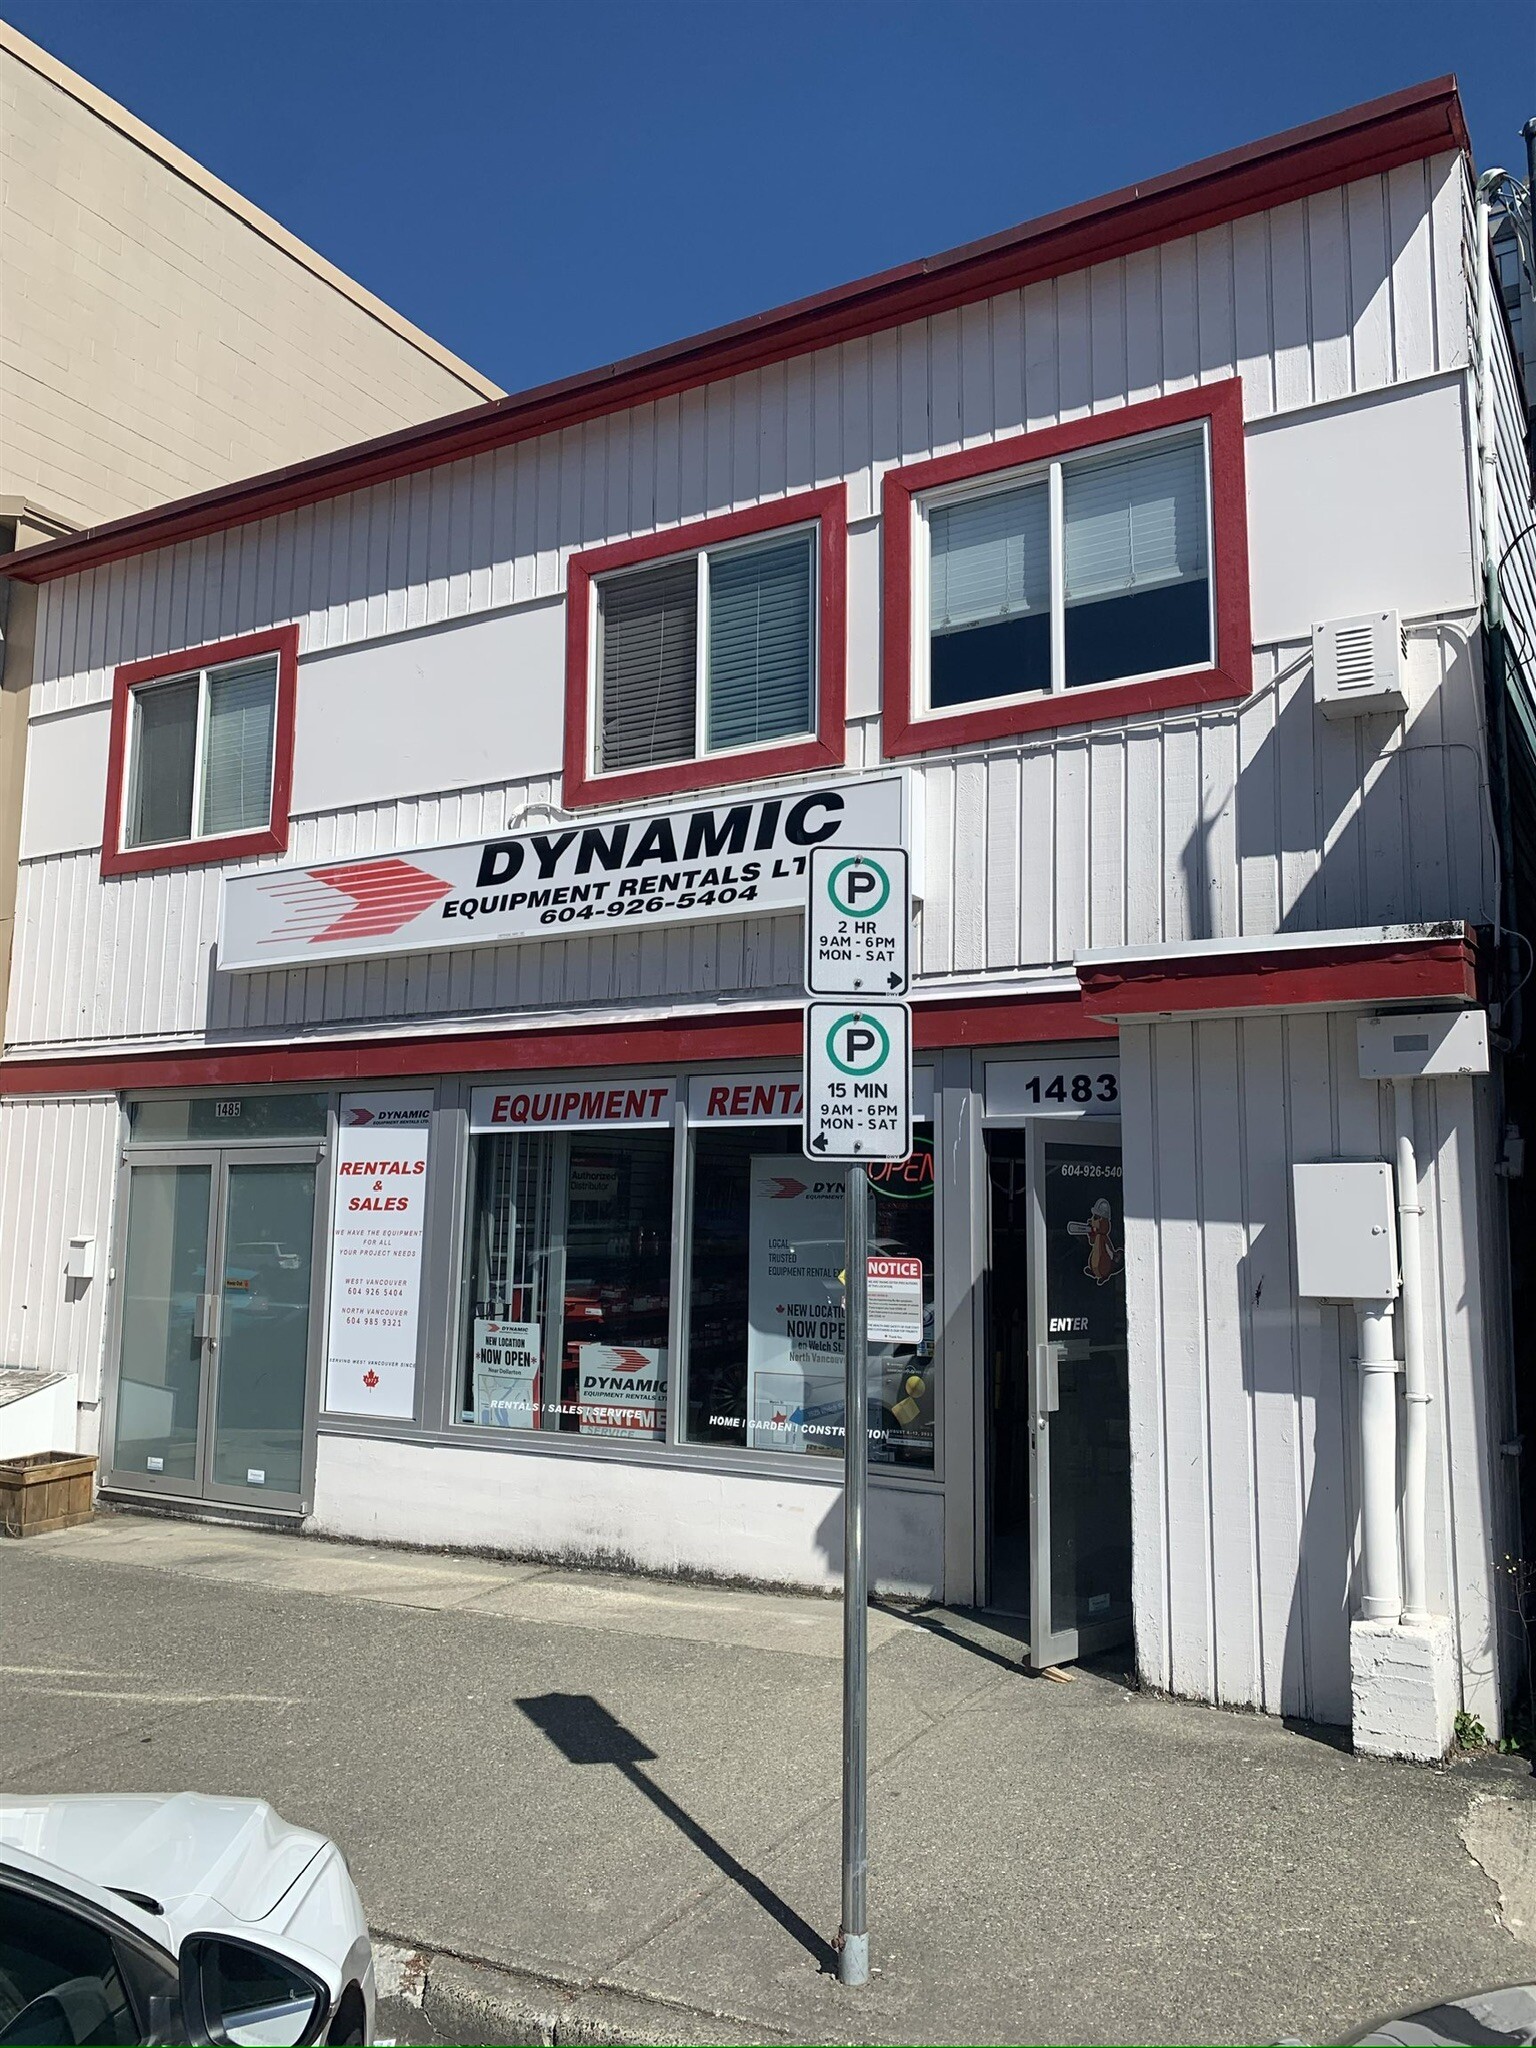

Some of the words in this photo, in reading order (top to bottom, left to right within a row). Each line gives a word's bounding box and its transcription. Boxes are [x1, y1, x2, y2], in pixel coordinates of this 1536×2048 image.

[476, 791, 845, 888] DYNAMIC
[441, 881, 610, 920] EQUIPMENT
[618, 861, 761, 898] RENTALS
[771, 856, 806, 879] LT
[847, 871, 876, 904] P
[540, 885, 758, 924] 604-926-5404
[838, 921, 847, 933] 2
[855, 921, 876, 934] HR
[819, 949, 852, 960] MON
[866, 951, 895, 961] SAT
[847, 1029, 875, 1062] P
[827, 1083, 847, 1098] 15
[854, 1083, 888, 1098] MIN
[1025, 1073, 1118, 1103] 1483
[491, 1088, 669, 1124] EQUIPMENT
[707, 1084, 804, 1116] RENT
[217, 1103, 240, 1116] 1485
[378, 1110, 430, 1120] DYNAMIC
[820, 1118, 853, 1129] MON
[868, 1119, 897, 1130] SAT
[339, 1161, 425, 1176] RENTALS
[1061, 1164, 1122, 1178] 604-926-540
[373, 1180, 383, 1191] &
[348, 1197, 409, 1211] SALES
[768, 1239, 789, 1248] LOCAL
[768, 1253, 797, 1263] TRUSTED
[768, 1267, 806, 1276] EQUIPMENT
[807, 1268, 832, 1277] RENTAL
[868, 1262, 918, 1275] NOTICE
[367, 1308, 408, 1316] VANCOUVER
[787, 1304, 807, 1317] NEW
[382, 1319, 401, 1327] 9321
[787, 1320, 816, 1338] NOW
[820, 1321, 845, 1340] OPE
[1050, 1317, 1089, 1332] ENTER
[485, 1336, 497, 1346] NEW
[499, 1338, 525, 1348] LOCATION
[809, 1340, 831, 1351] Welch
[833, 1341, 844, 1352] St.
[481, 1348, 501, 1364] NOW
[505, 1350, 530, 1367] OPEN
[790, 1352, 810, 1362] North
[812, 1353, 845, 1364] Vancouv
[584, 1376, 667, 1393] DYNAMIC
[491, 1400, 538, 1412] RENTALS
[548, 1405, 583, 1414] SALES
[593, 1407, 642, 1419] SERVICE
[709, 1416, 739, 1427] HOME
[749, 1420, 791, 1431] GARDEN
[801, 1424, 890, 1440] CONSTRION
